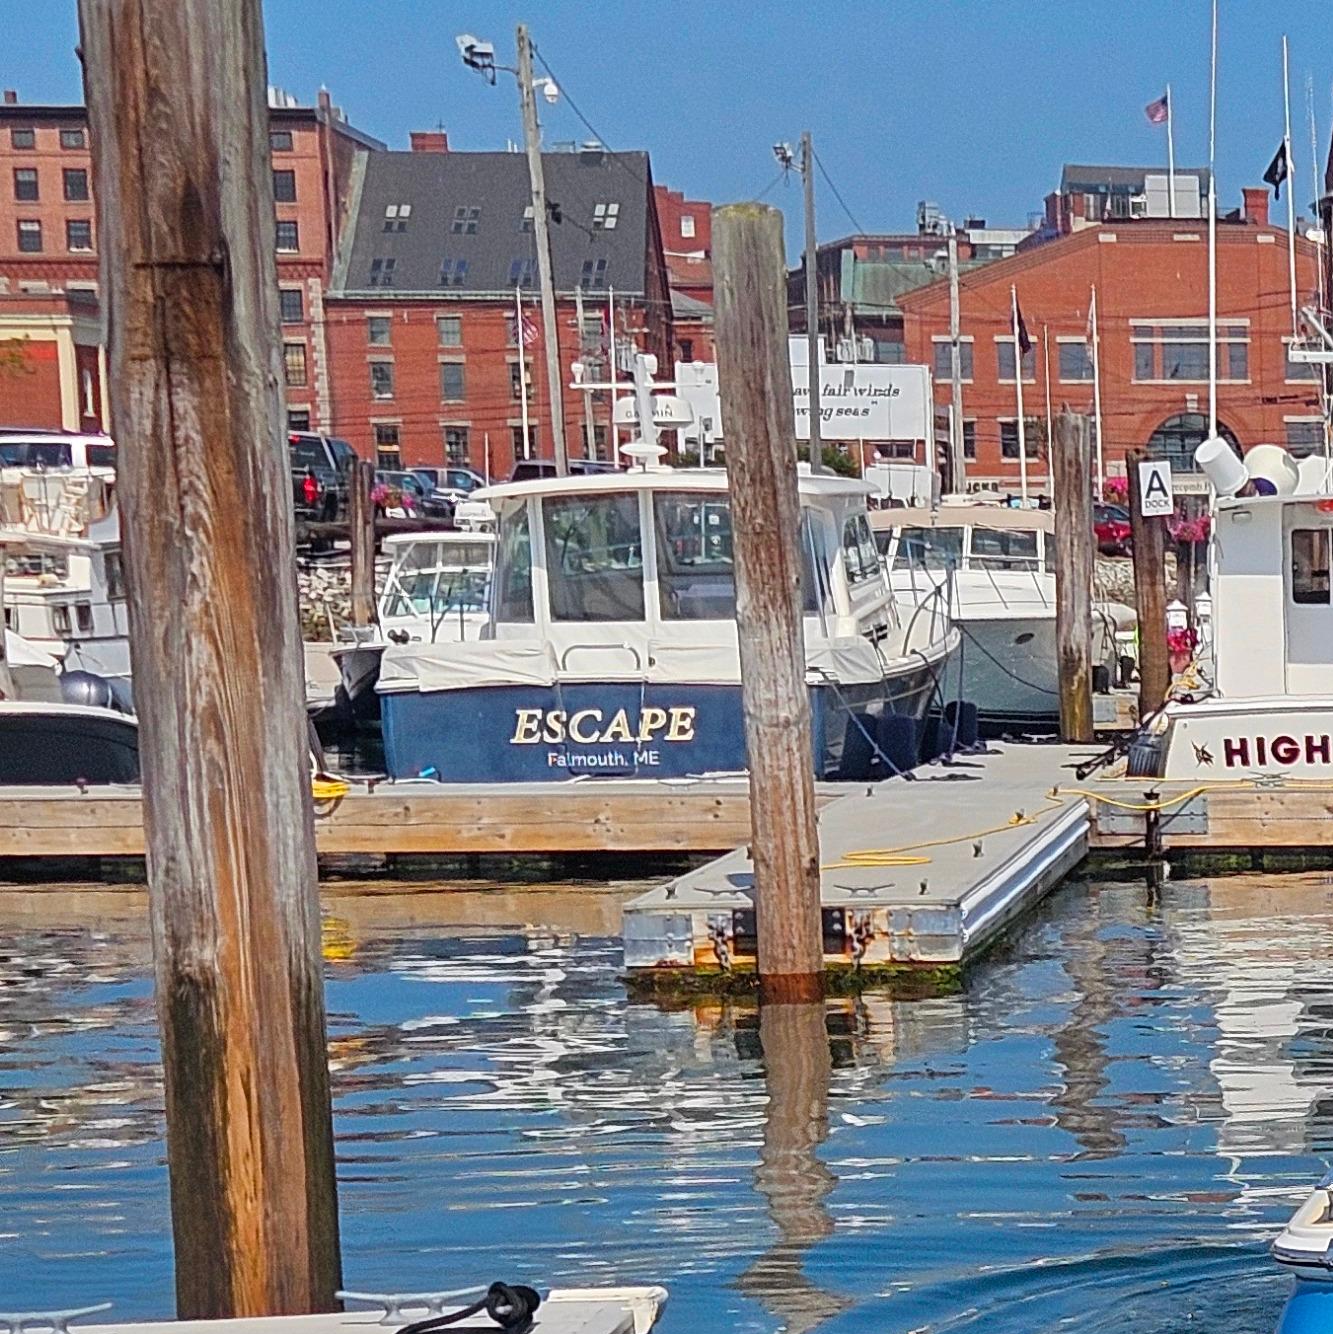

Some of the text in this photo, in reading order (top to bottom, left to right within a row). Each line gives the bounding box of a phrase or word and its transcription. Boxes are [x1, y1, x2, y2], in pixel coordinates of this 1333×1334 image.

[625, 409, 673, 418] GAMIN
[1145, 469, 1169, 499] A
[1144, 500, 1170, 509] DOCK
[510, 707, 696, 744] ESCAPE
[633, 750, 661, 766] ME
[1223, 734, 1331, 768] HIGH
